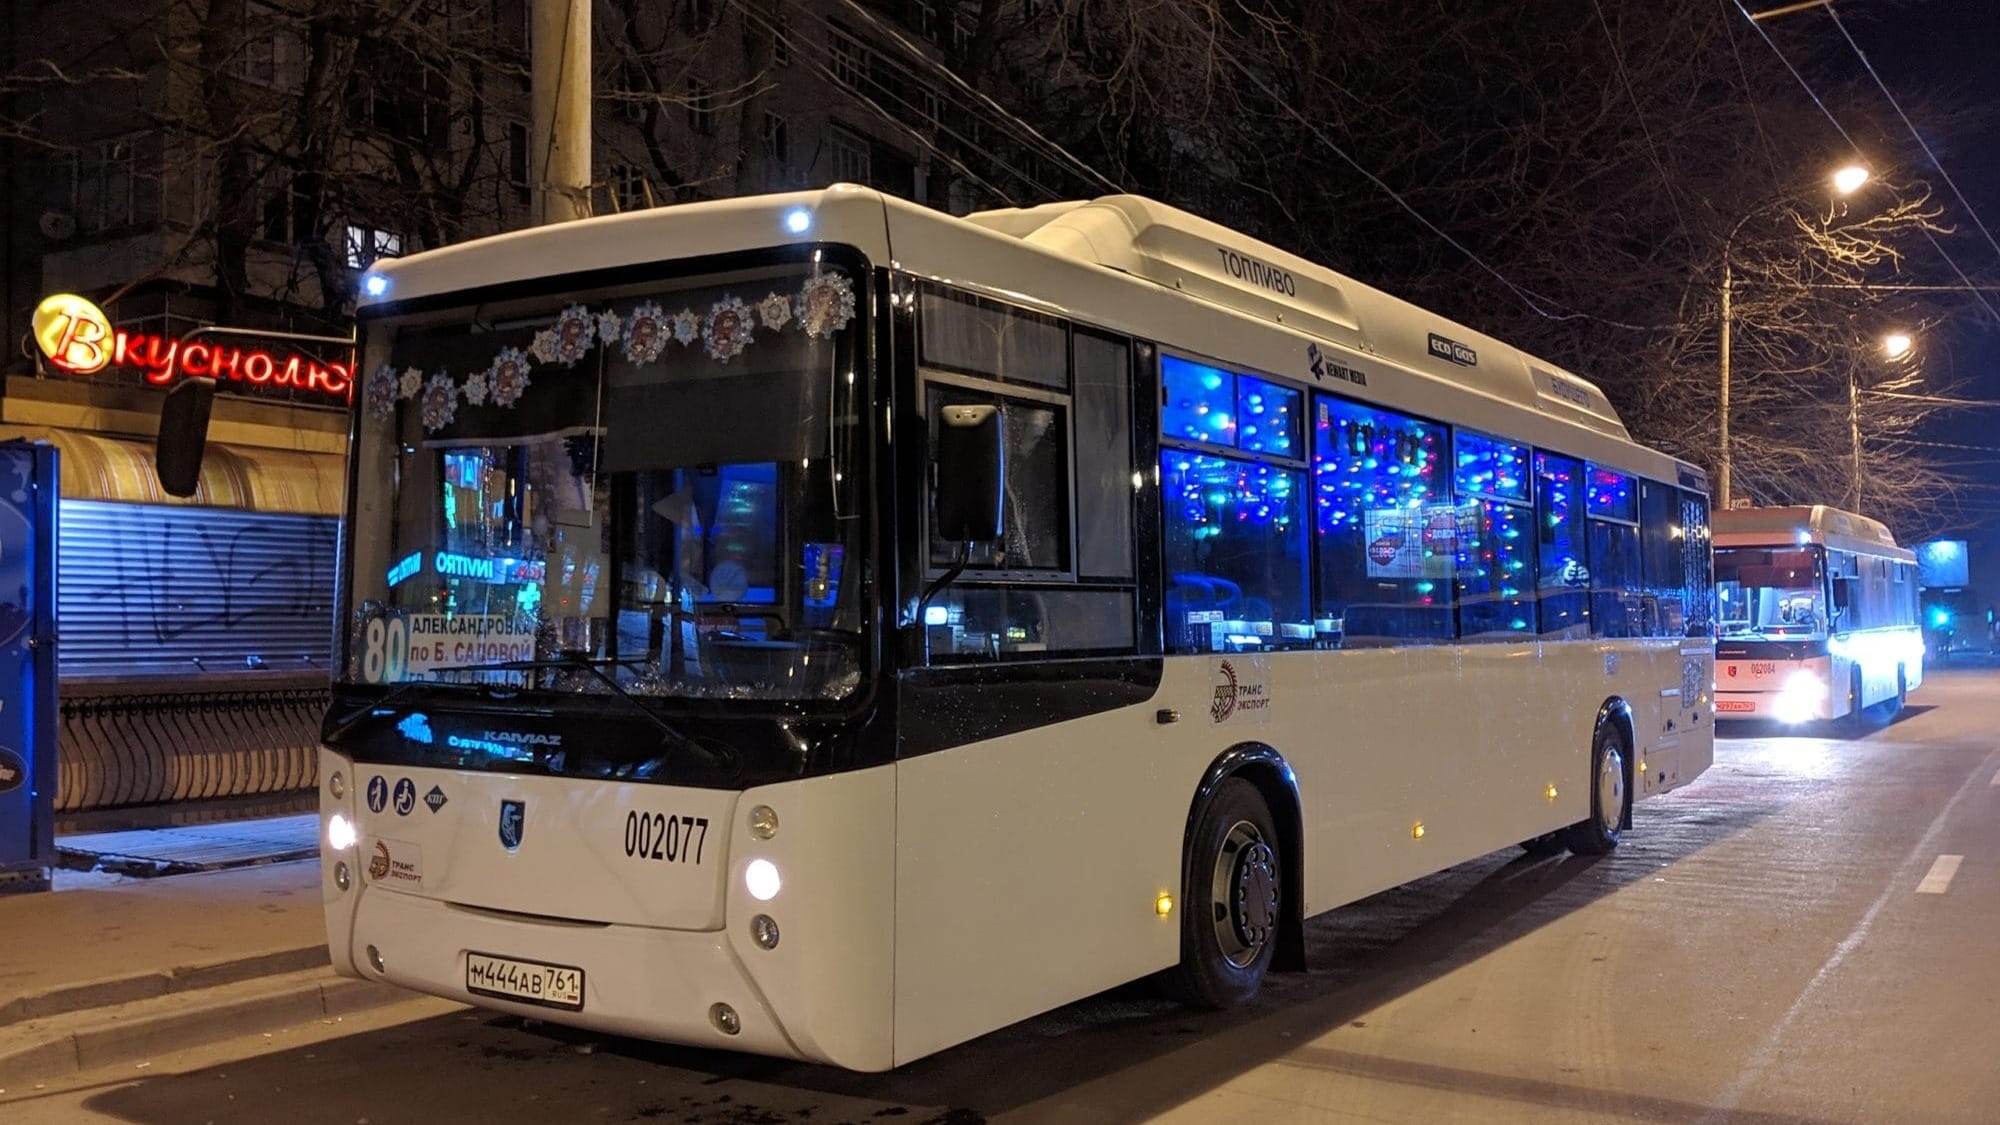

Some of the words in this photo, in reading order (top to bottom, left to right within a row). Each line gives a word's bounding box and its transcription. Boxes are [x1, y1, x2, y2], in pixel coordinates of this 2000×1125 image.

[1218, 248, 1296, 298] ТОПЛИВО
[412, 617, 532, 637] АЛЕКСАНДРОВКА
[364, 617, 405, 684] 80
[410, 645, 429, 661] по
[434, 642, 449, 662] Б.
[454, 639, 531, 663] САДОВОЙ
[1239, 684, 1262, 697] ТРАНС
[1237, 698, 1270, 710] ЭКСПОРТ
[484, 731, 562, 746] KAMAZ
[625, 810, 709, 865] 002077
[552, 990, 567, 1000] RUS
